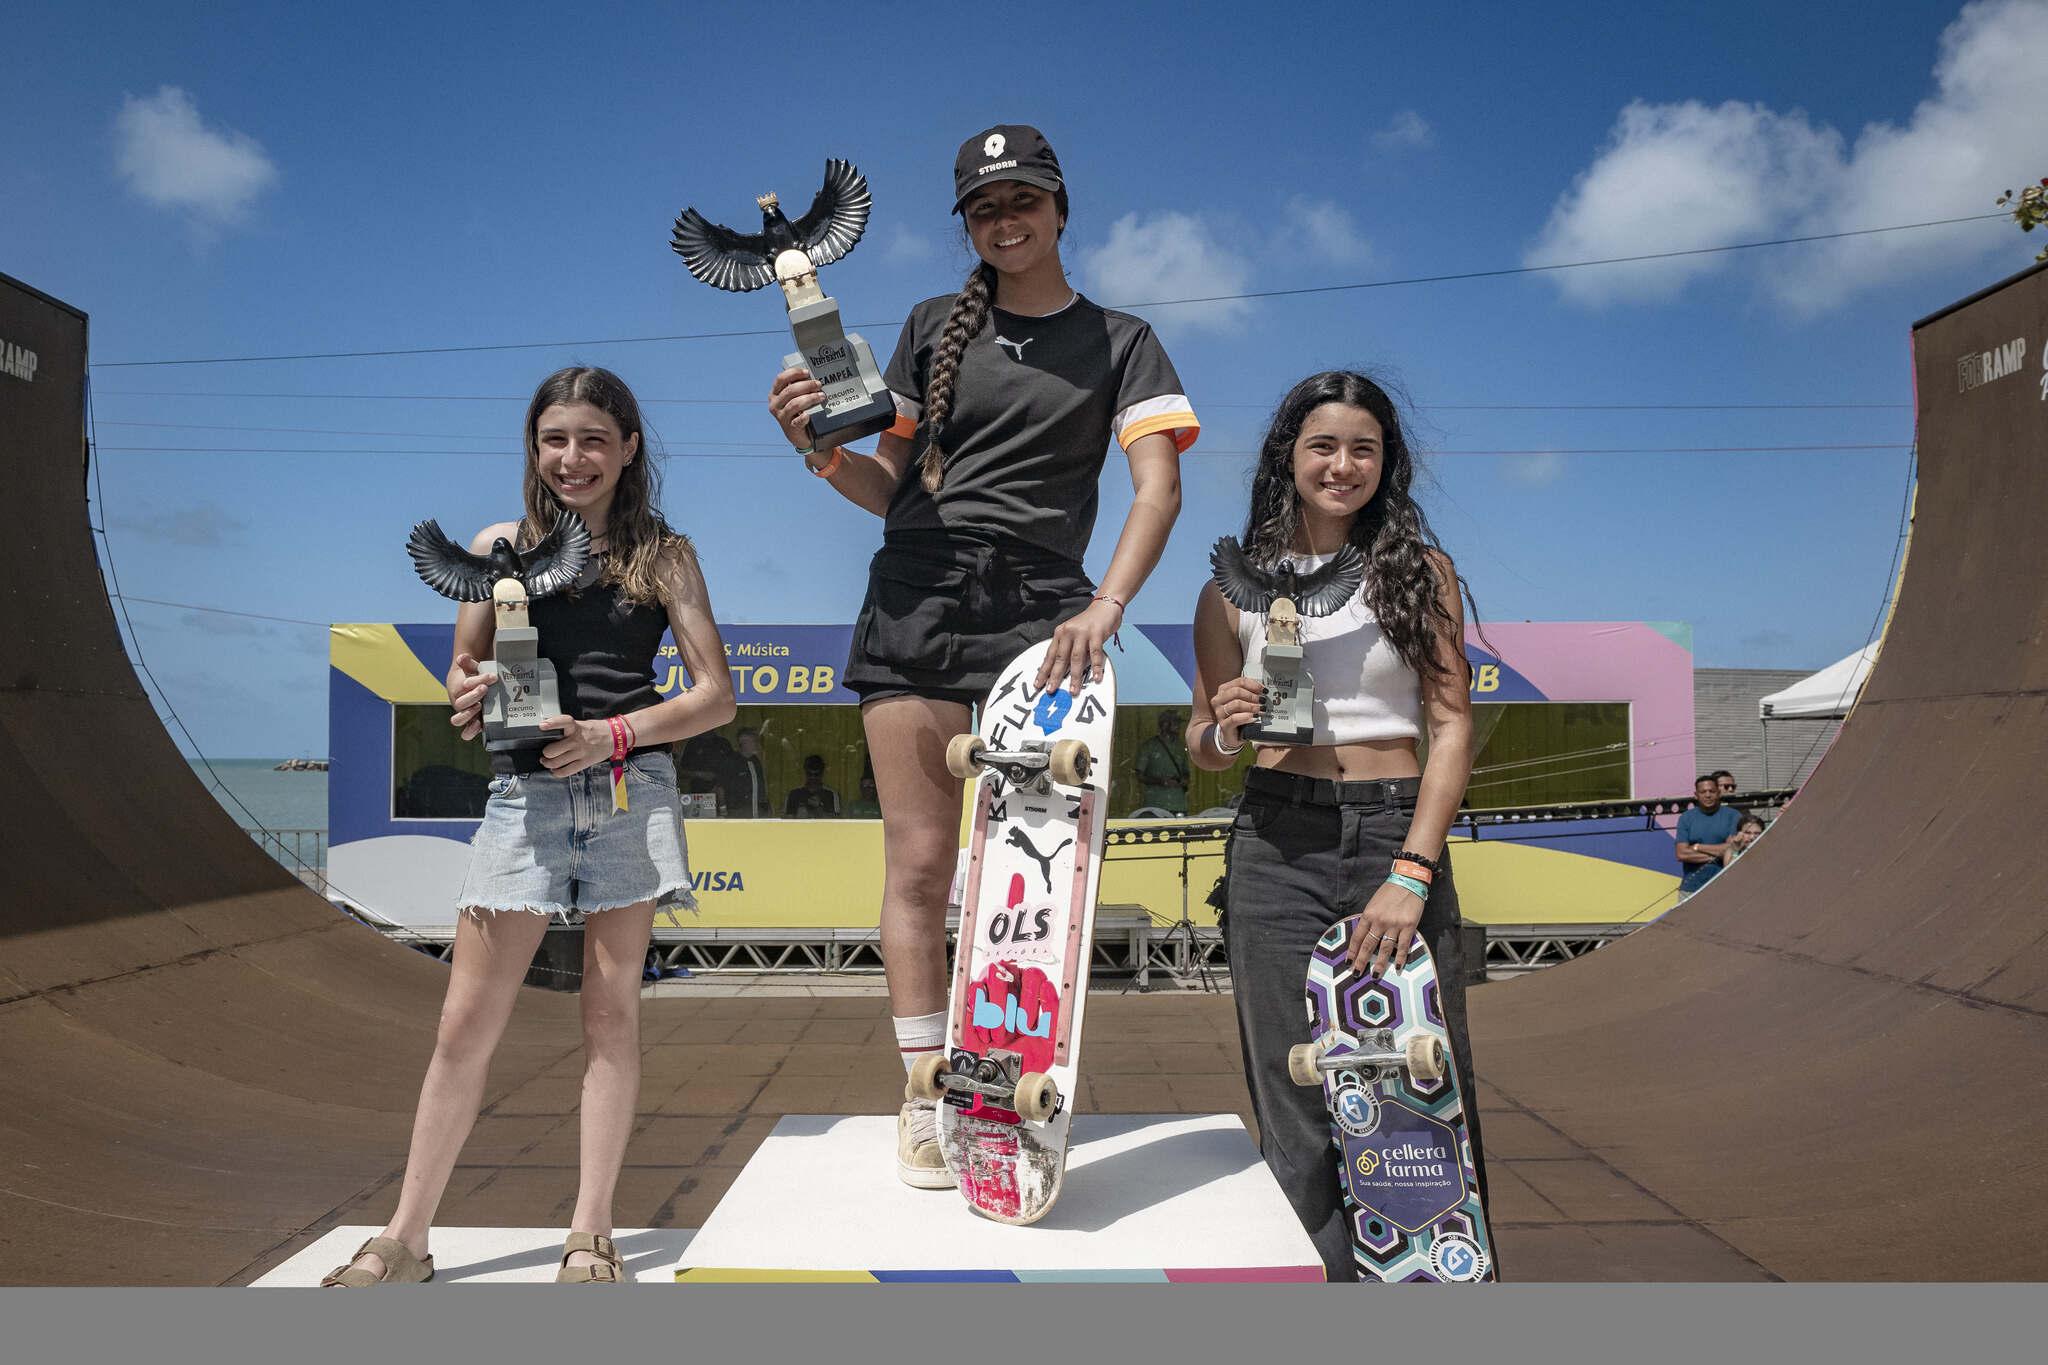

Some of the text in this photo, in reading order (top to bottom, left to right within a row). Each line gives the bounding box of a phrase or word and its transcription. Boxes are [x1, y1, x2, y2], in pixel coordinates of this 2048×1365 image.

[978, 160, 1017, 175] STHORM
[737, 641, 790, 657] Música
[786, 665, 835, 694] BB
[689, 871, 744, 892] VISA
[989, 908, 1052, 945] OLS
[973, 988, 1052, 1039] blu
[1381, 1143, 1447, 1160] cellera
[1384, 1160, 1444, 1178] farma
